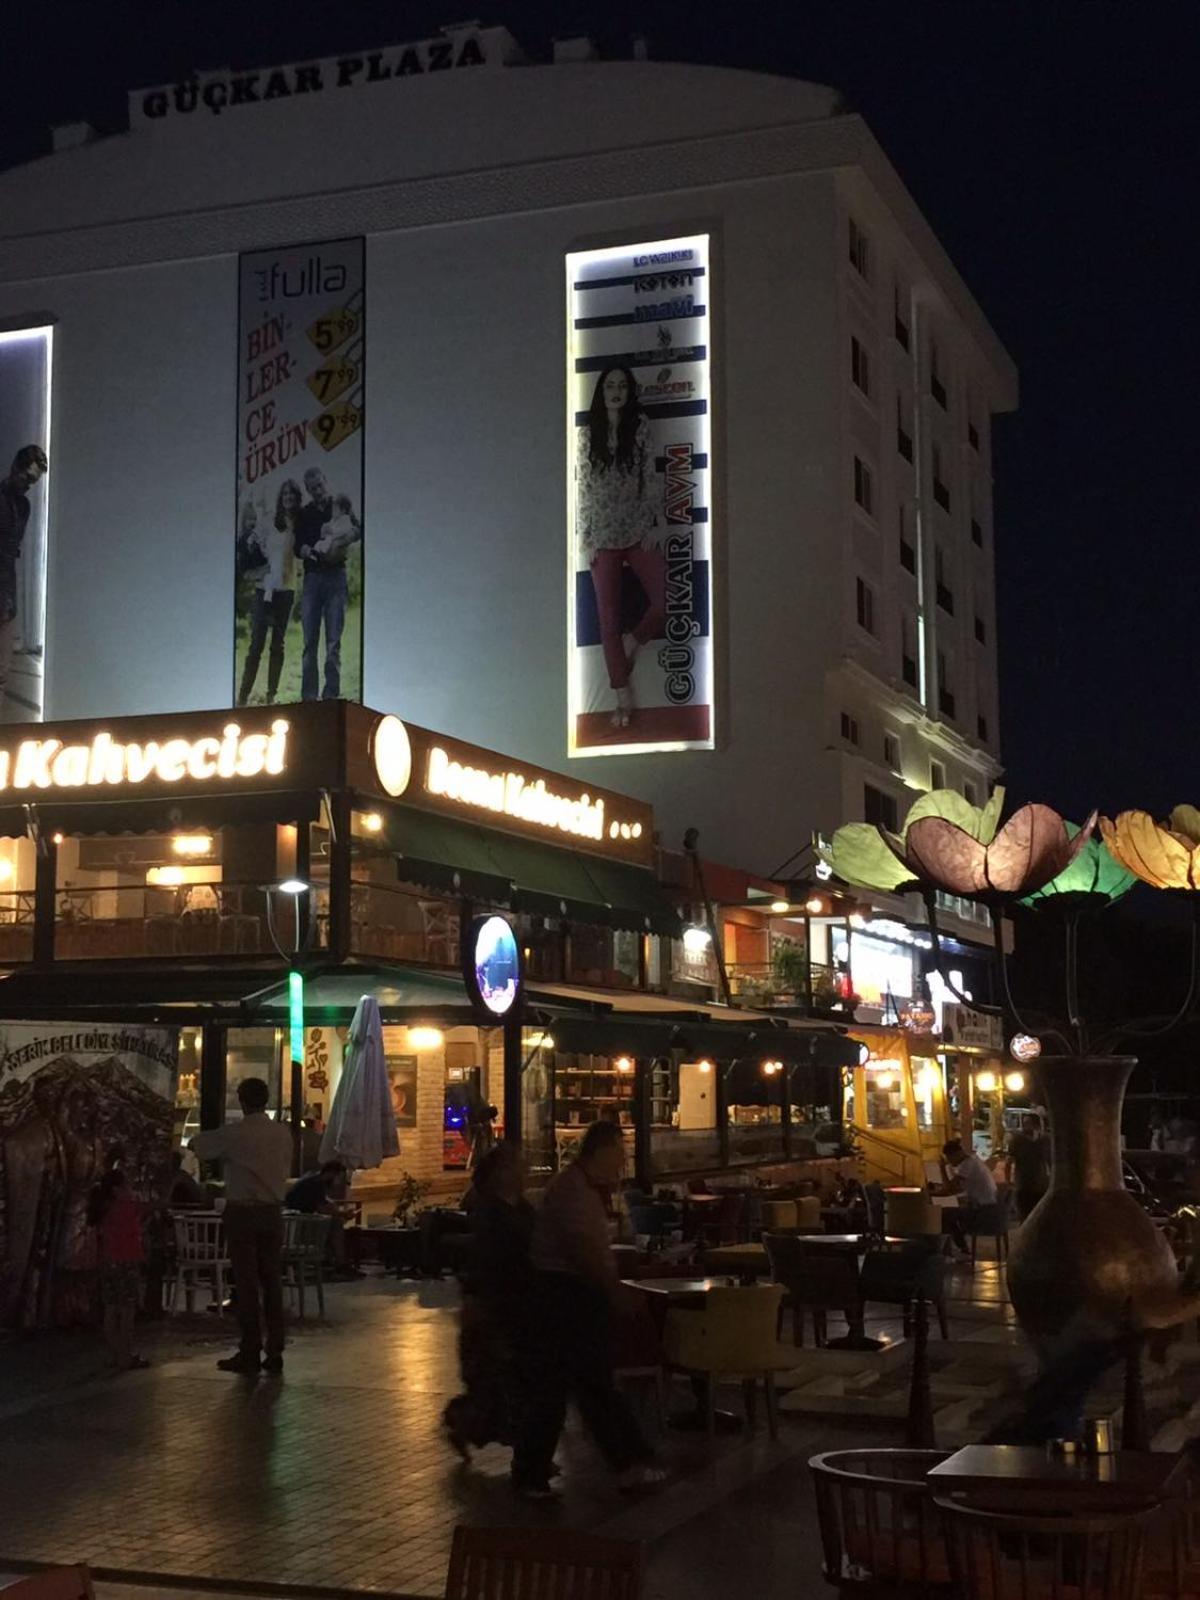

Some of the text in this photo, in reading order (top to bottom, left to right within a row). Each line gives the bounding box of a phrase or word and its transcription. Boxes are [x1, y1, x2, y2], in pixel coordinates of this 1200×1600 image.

[143, 38, 486, 118] GÜÇKAR PLAZA
[270, 257, 346, 300] fulla
[246, 400, 275, 442] CE
[246, 420, 308, 483] ÜRÜN
[665, 443, 697, 525] AVM
[659, 532, 701, 704] GÜÇKAR
[13, 719, 290, 788] Kahvecisi
